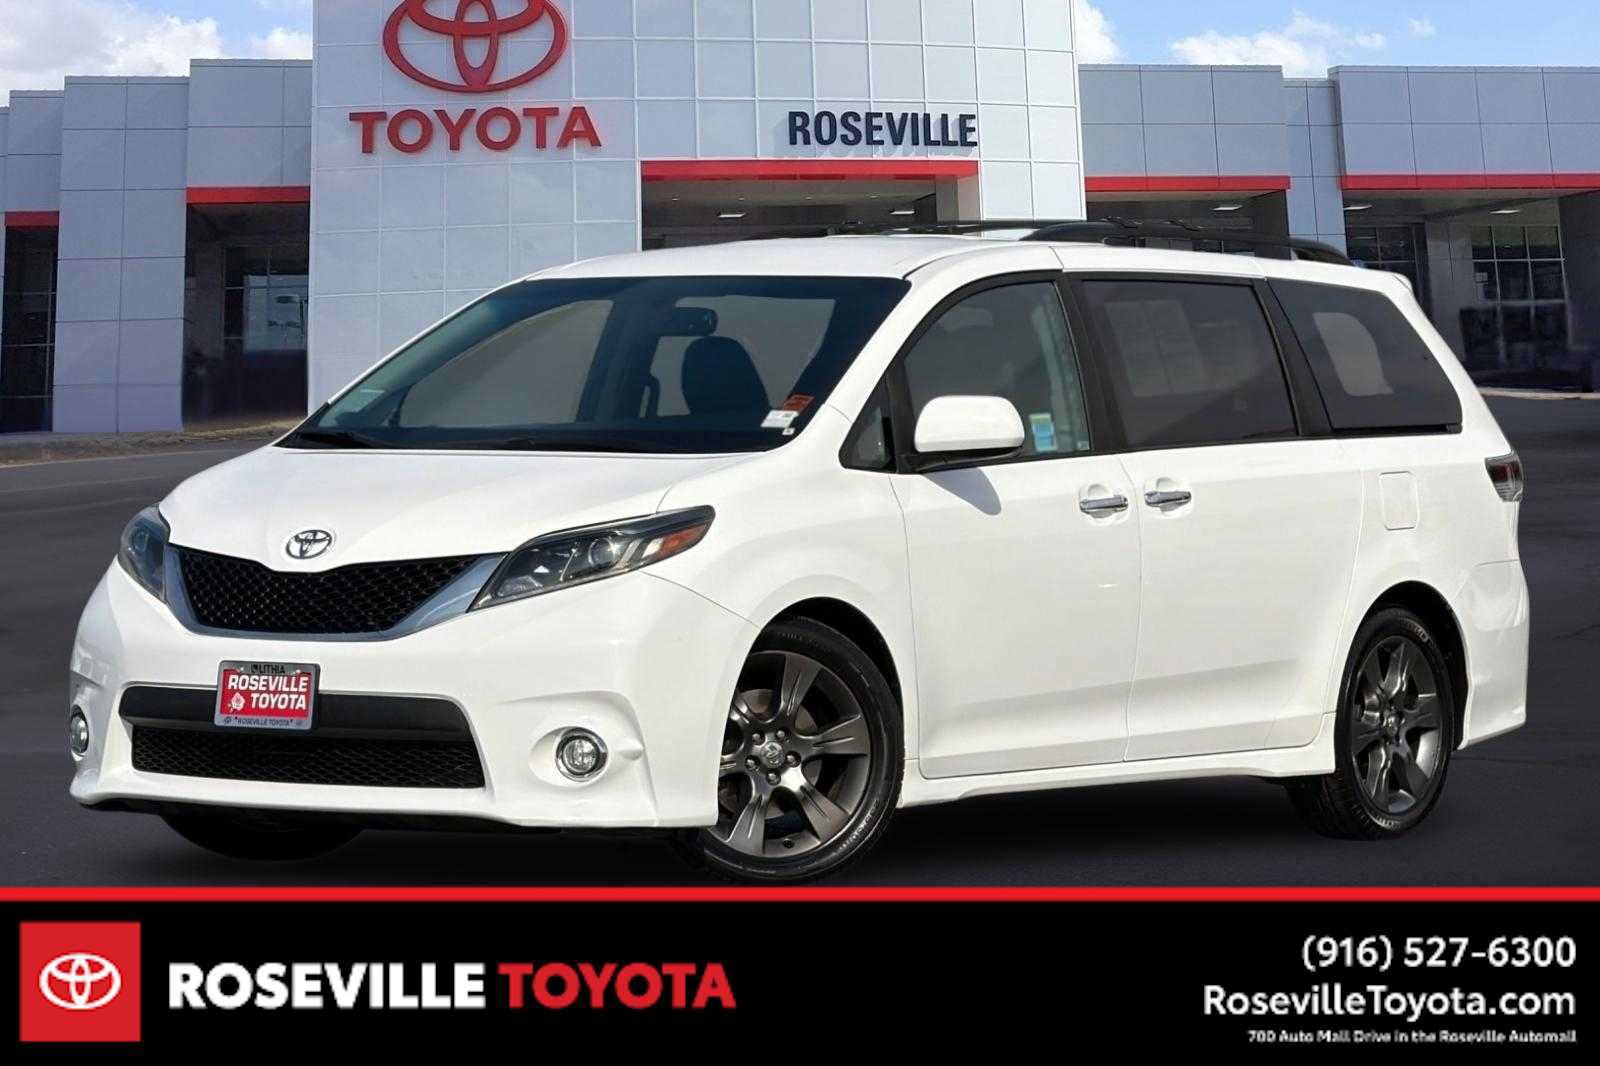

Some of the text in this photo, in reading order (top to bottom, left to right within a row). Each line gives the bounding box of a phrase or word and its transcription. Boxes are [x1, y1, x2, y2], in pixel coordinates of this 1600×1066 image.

[349, 106, 602, 154] TOYOTA
[788, 111, 978, 147] ROSEVILLE
[258, 664, 286, 674] LITHIA
[227, 674, 309, 692] ROSEVILLE
[250, 693, 307, 710] TOYOTA
